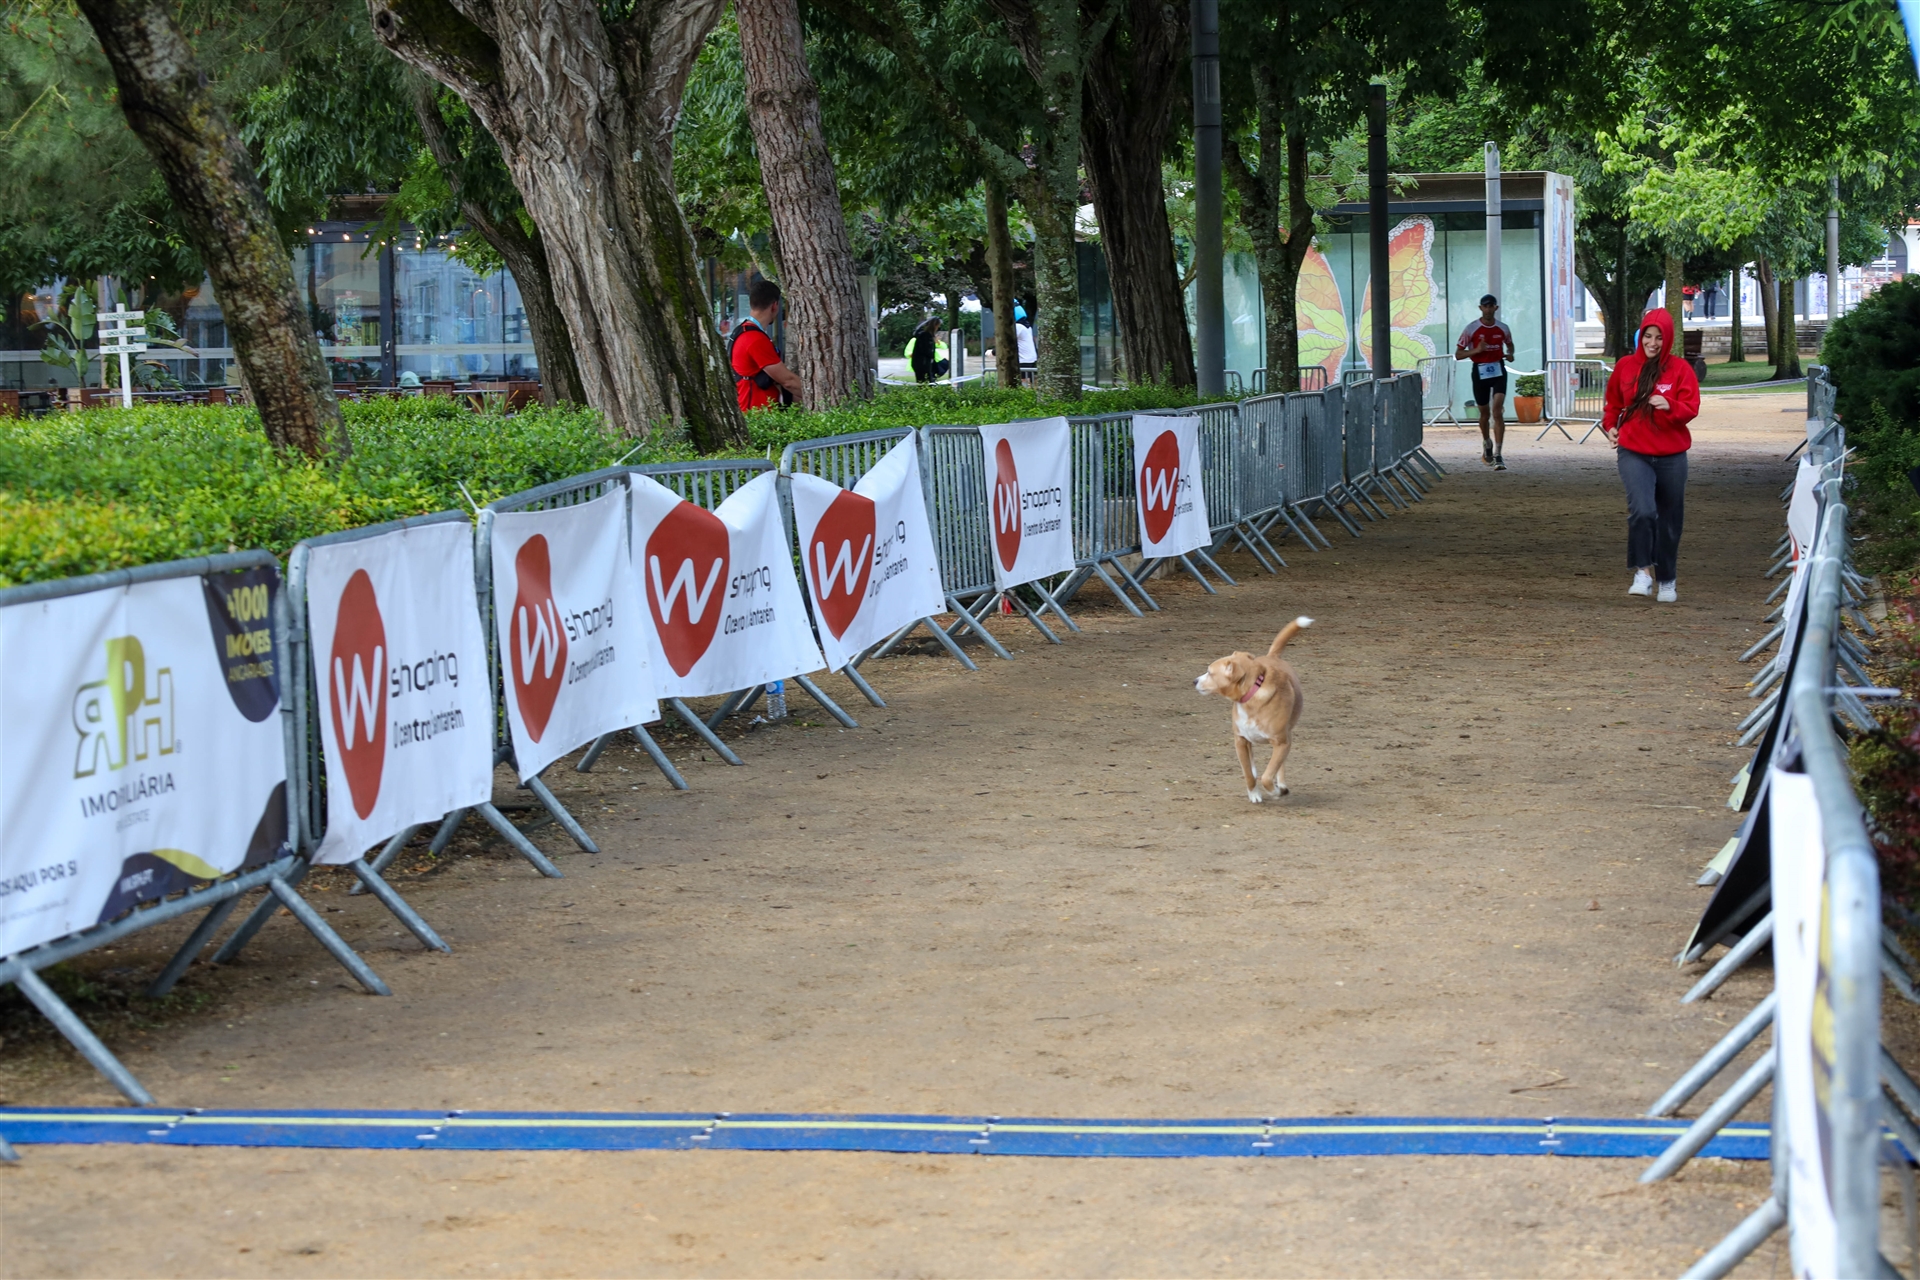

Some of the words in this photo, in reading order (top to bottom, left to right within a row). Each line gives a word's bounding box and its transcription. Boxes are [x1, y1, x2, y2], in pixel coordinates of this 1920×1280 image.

[1485, 365, 1496, 373] 43
[1022, 486, 1061, 511] shopping
[40, 863, 65, 884] POR
[67, 859, 78, 877] SI
